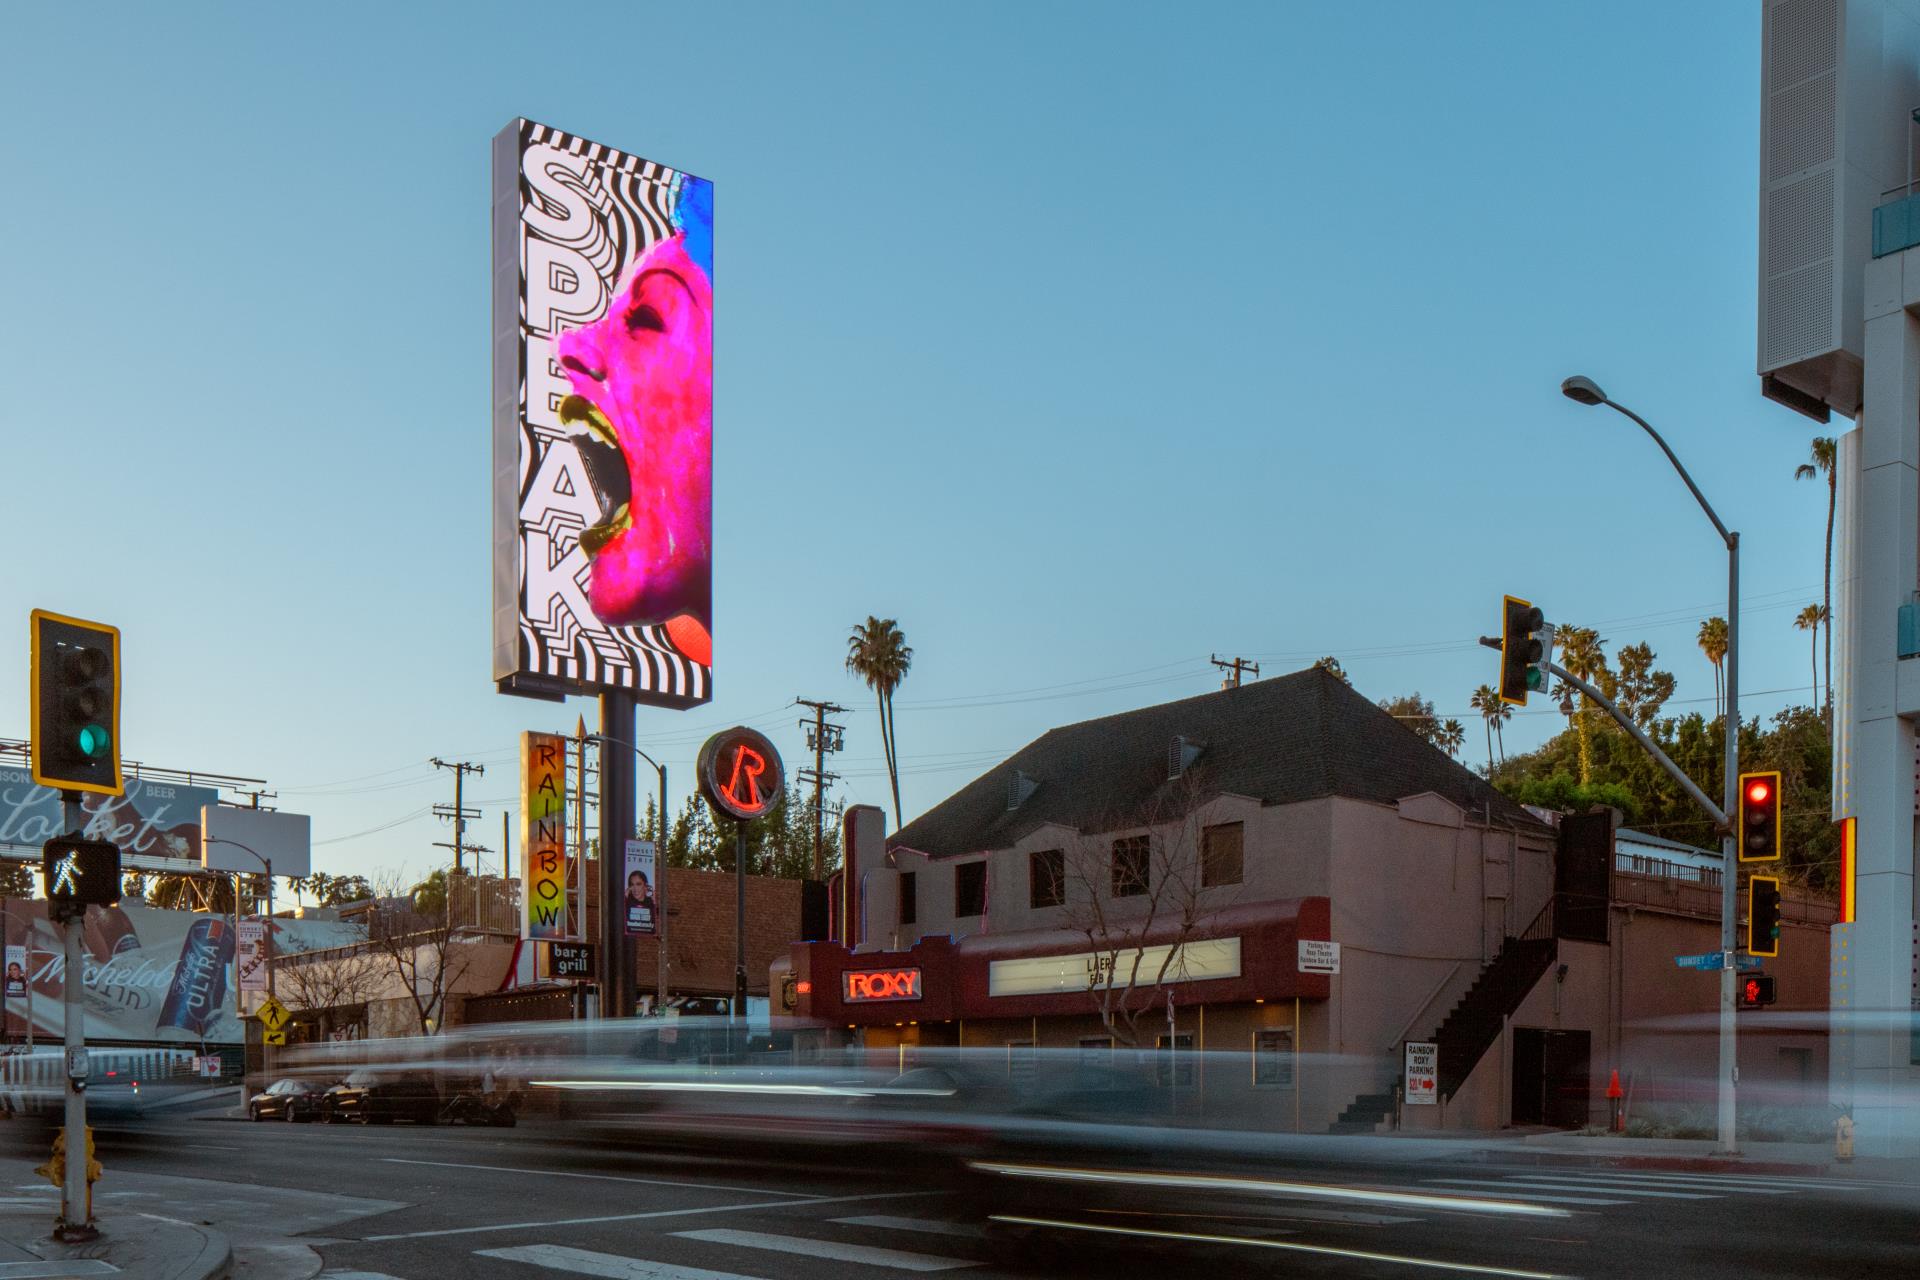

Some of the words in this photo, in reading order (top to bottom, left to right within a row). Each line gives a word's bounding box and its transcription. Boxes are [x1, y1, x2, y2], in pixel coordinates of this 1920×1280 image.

[146, 785, 176, 799] BEER
[535, 744, 559, 927] RAINBOW
[554, 943, 577, 958] bar
[580, 949, 588, 958] &
[559, 959, 587, 975] grill
[187, 945, 219, 1008] ULTRA
[849, 970, 917, 999] ROXY
[1408, 1045, 1435, 1055] RAINBOW
[1414, 1056, 1429, 1065] ROXY
[1409, 1066, 1434, 1075] PARKING
